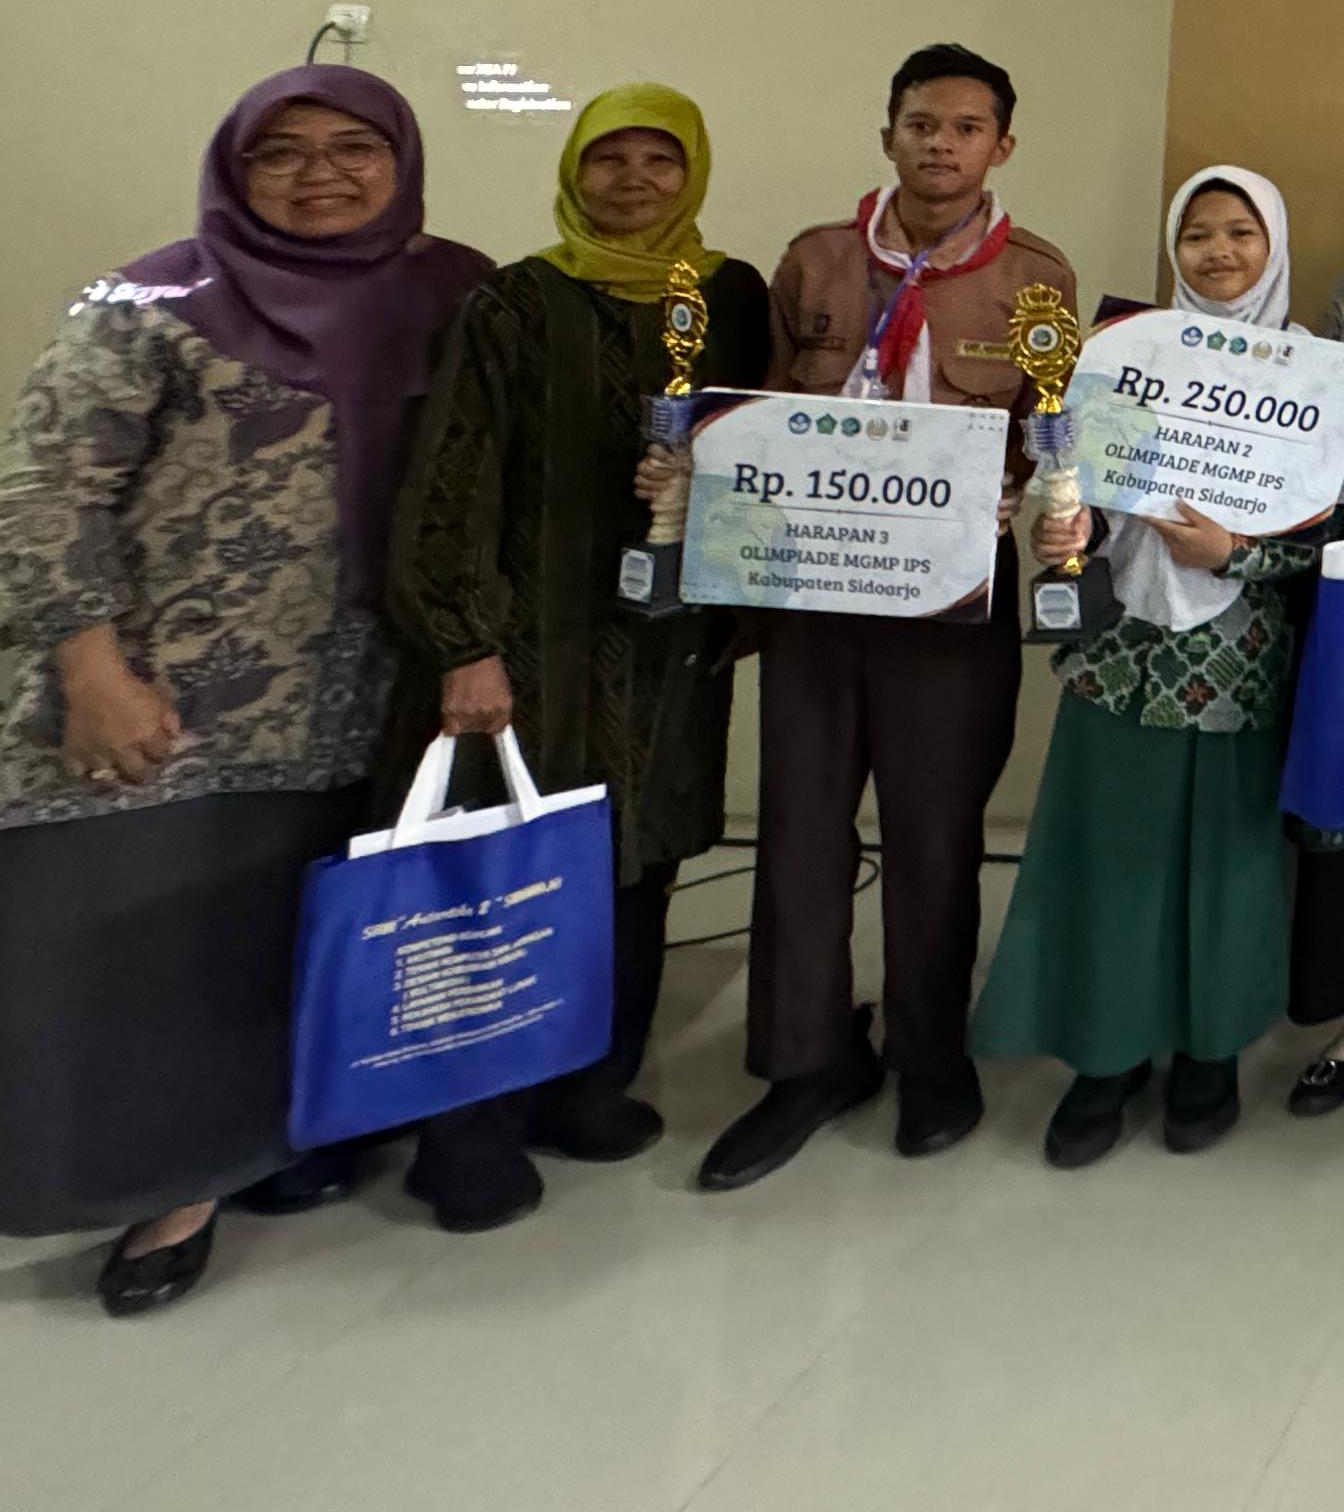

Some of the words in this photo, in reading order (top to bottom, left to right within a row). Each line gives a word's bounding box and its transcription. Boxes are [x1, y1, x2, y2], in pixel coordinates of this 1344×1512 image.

[1113, 365, 1171, 408] Rp.
[1181, 380, 1321, 433] 250.000
[1154, 425, 1241, 456] HARAPAN
[1241, 443, 1253, 458] 2
[733, 463, 794, 503] Rp.
[805, 469, 952, 508] 150.000
[1104, 442, 1201, 473] OLIMPIADE
[1201, 461, 1256, 485] MGMP
[1257, 473, 1286, 491] IPS
[1103, 468, 1195, 500] Kabupaten
[1198, 486, 1268, 515] Sidoarjo
[786, 522, 876, 544] HARAPAN
[878, 530, 890, 544] 3
[740, 545, 840, 568] OLIMPIADE
[843, 553, 901, 572] MGMP
[903, 557, 932, 574] IPS
[747, 571, 844, 593] Kabupaten
[847, 577, 921, 600] Sidoarjo
